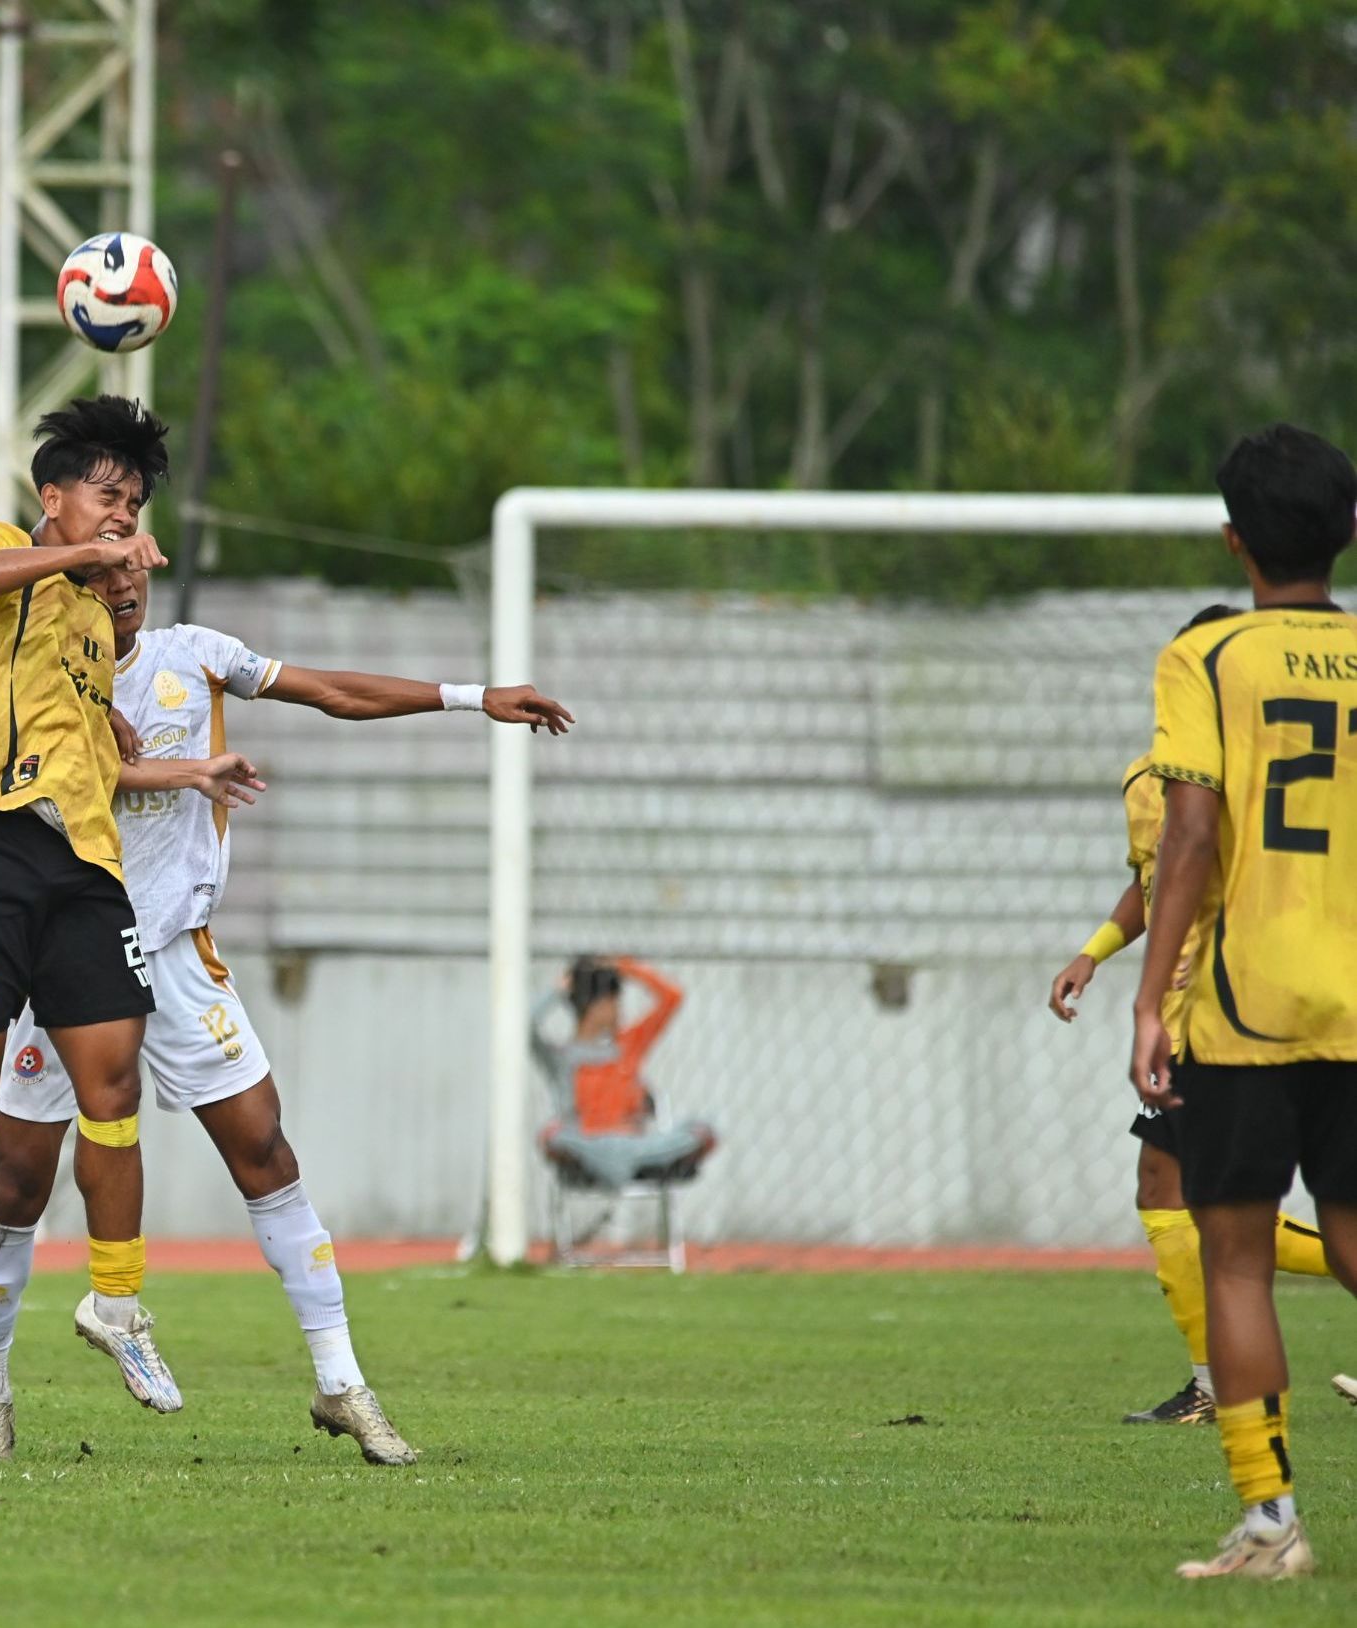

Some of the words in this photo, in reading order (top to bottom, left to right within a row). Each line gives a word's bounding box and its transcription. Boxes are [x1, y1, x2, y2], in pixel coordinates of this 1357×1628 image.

[142, 728, 188, 750] GROUP
[1262, 698, 1357, 856] 2
[200, 1003, 239, 1044] 12
